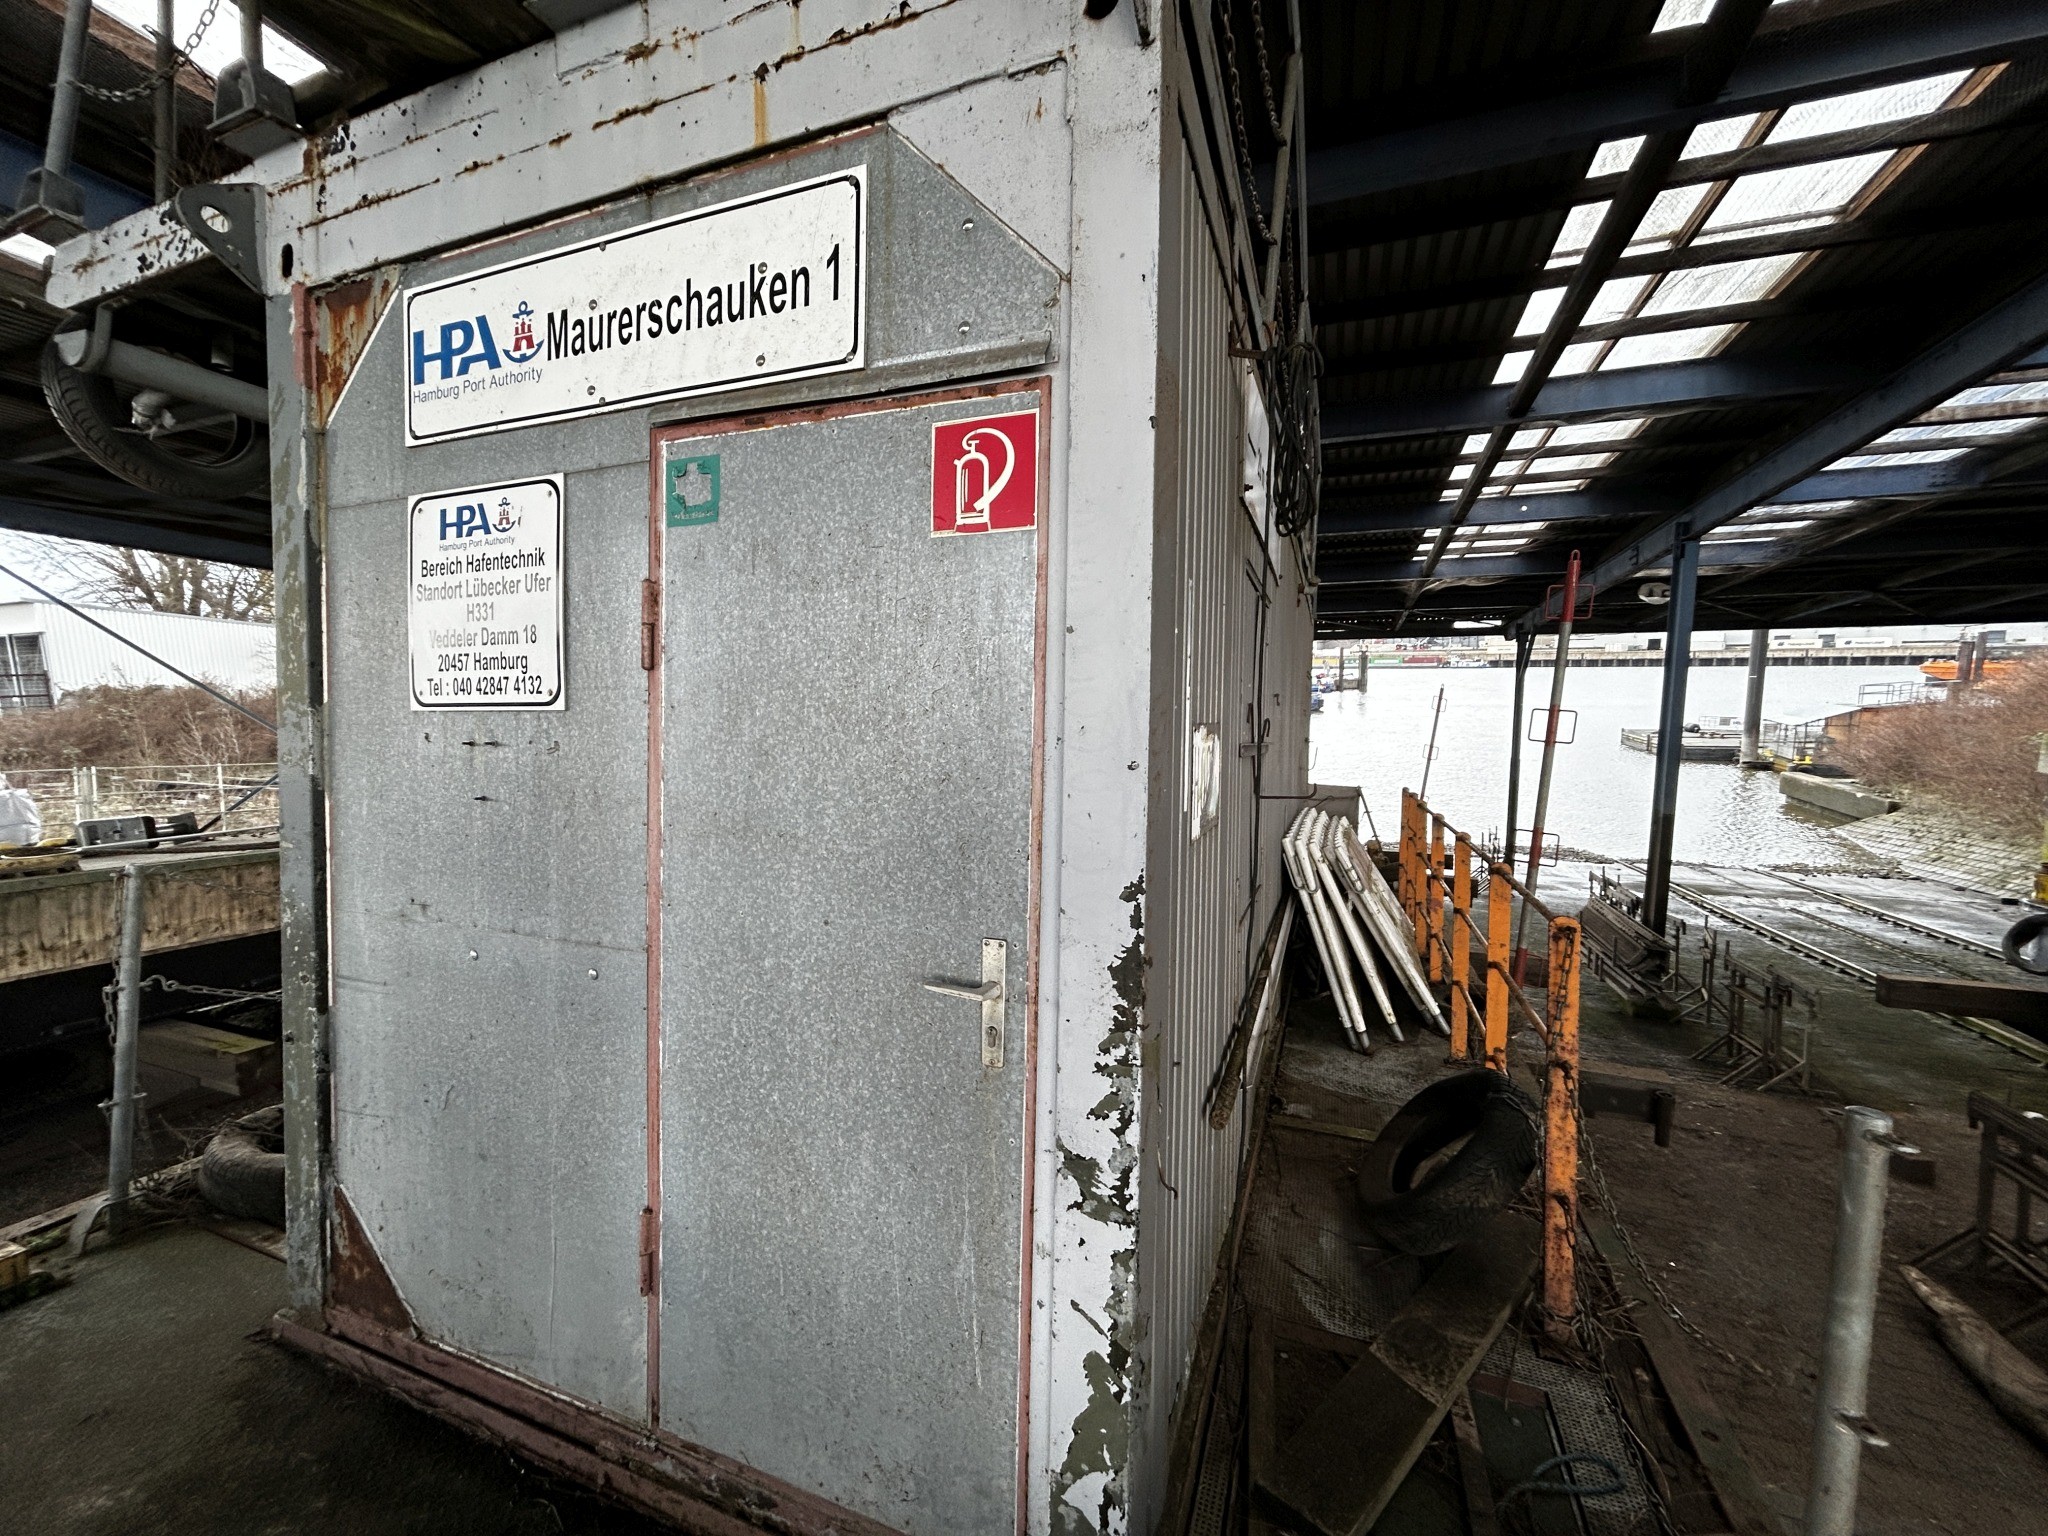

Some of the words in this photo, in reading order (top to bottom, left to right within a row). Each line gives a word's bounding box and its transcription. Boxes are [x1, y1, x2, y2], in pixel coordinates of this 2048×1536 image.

[547, 263, 811, 361] Maurerschauken
[826, 242, 841, 301] 1
[413, 315, 502, 386] HPA
[413, 382, 460, 404] Hamburg
[462, 375, 487, 395] Port
[489, 366, 543, 389] Authority
[440, 503, 492, 540] HPA
[439, 541, 467, 551] Hamburg
[468, 539, 483, 547] Port
[484, 536, 515, 546] Authority
[421, 555, 462, 577] Bereich
[466, 547, 545, 573] Hafentechnik
[416, 581, 463, 602] Standort
[466, 576, 521, 598] Lübecker
[524, 573, 551, 593] Ufer
[466, 602, 495, 622] H331
[429, 629, 477, 649] Veddeler
[481, 626, 519, 646] Damm
[523, 624, 537, 644] 18
[438, 653, 470, 672] 20457
[474, 652, 528, 674] Hamburg
[453, 677, 472, 695] 040
[476, 676, 509, 695] 42847
[513, 675, 543, 695] 4132
